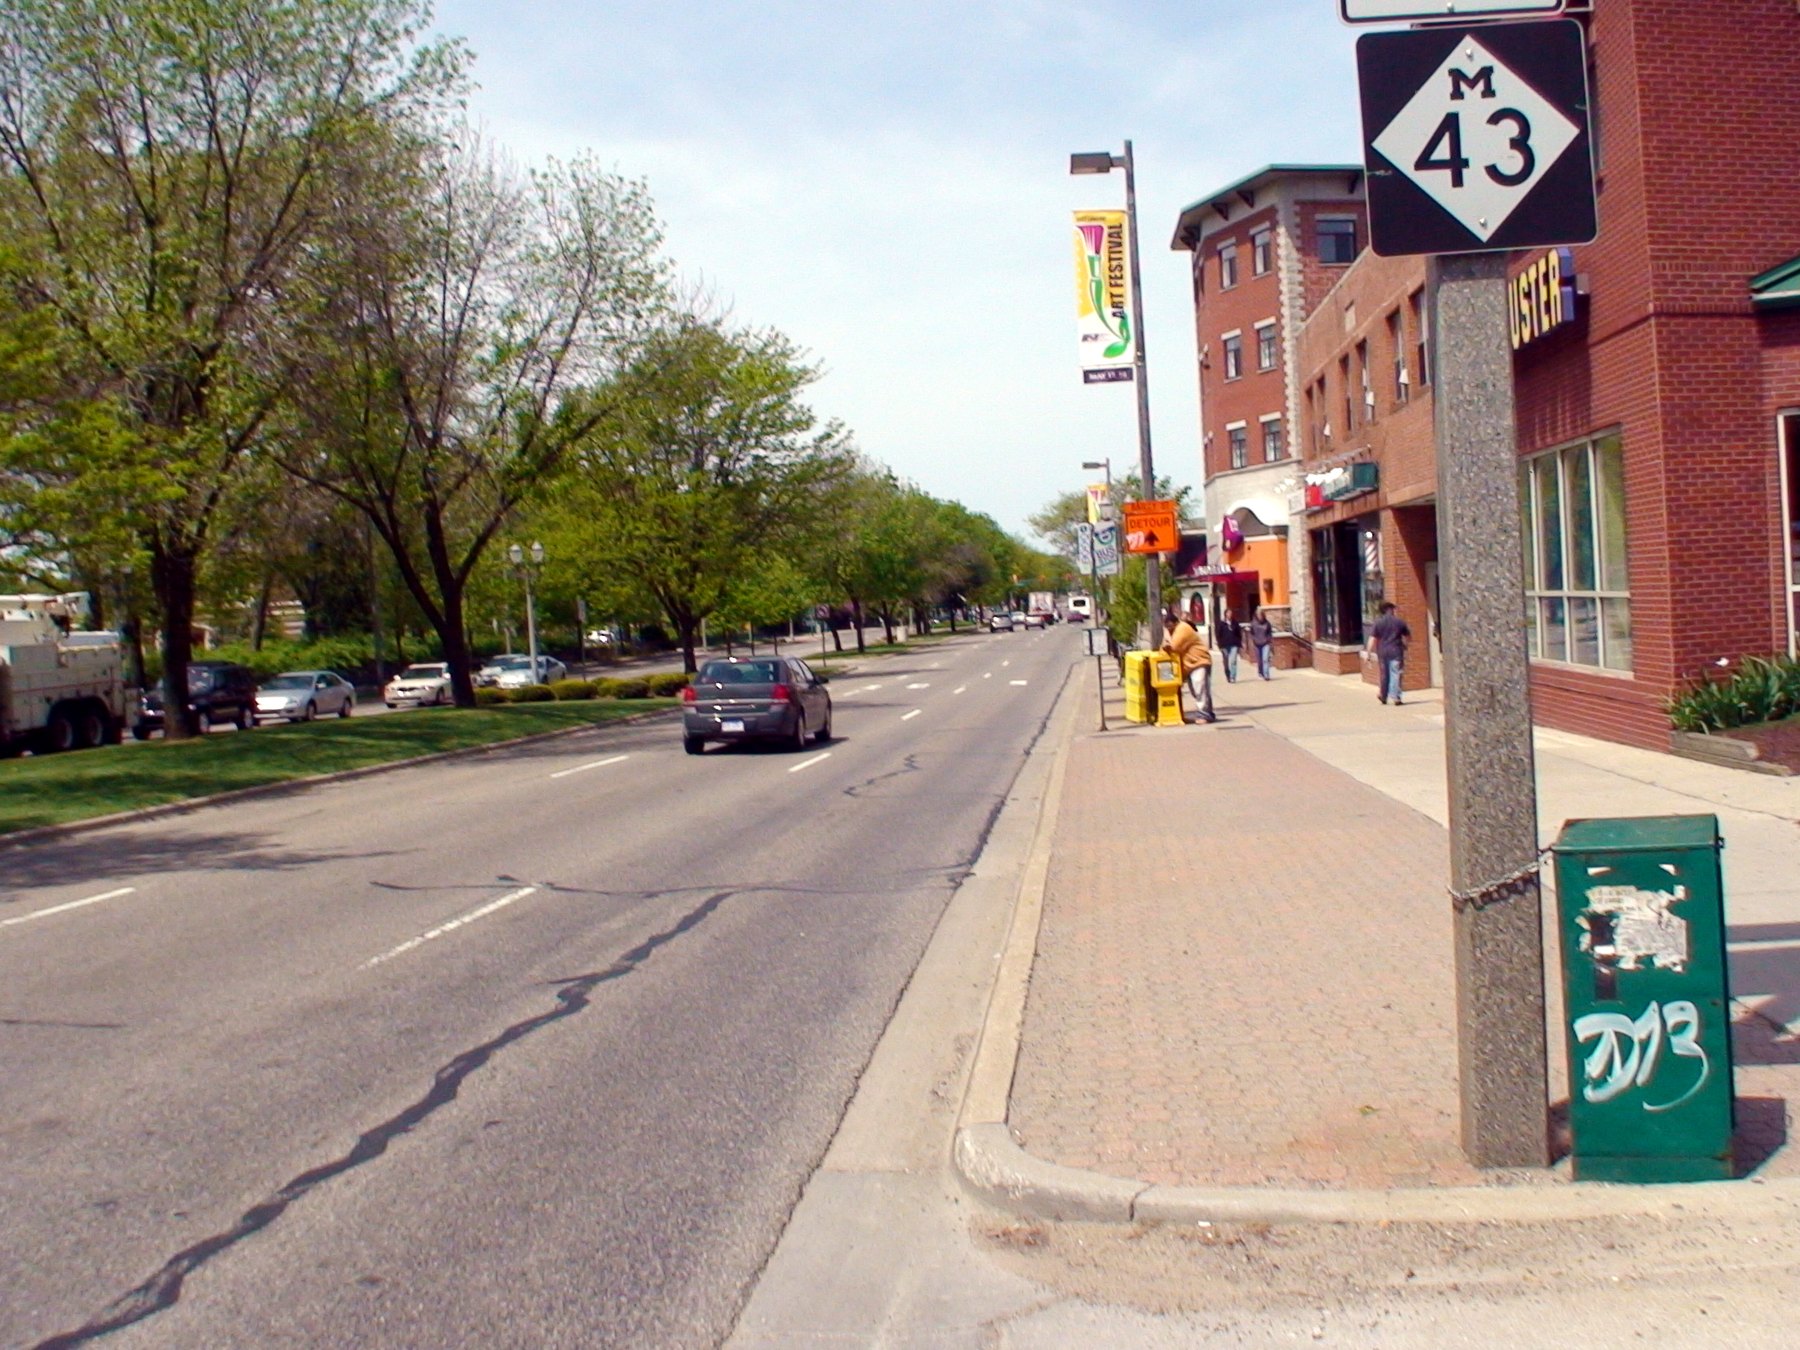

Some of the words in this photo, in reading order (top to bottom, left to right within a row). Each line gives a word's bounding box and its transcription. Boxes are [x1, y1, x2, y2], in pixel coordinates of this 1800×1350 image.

[1448, 66, 1496, 100] M
[1414, 107, 1535, 188] 43
[1107, 223, 1124, 288] FESTIVAL
[1110, 292, 1125, 320] ART
[1508, 248, 1562, 350] USTER
[1130, 517, 1171, 529] DETOUR
